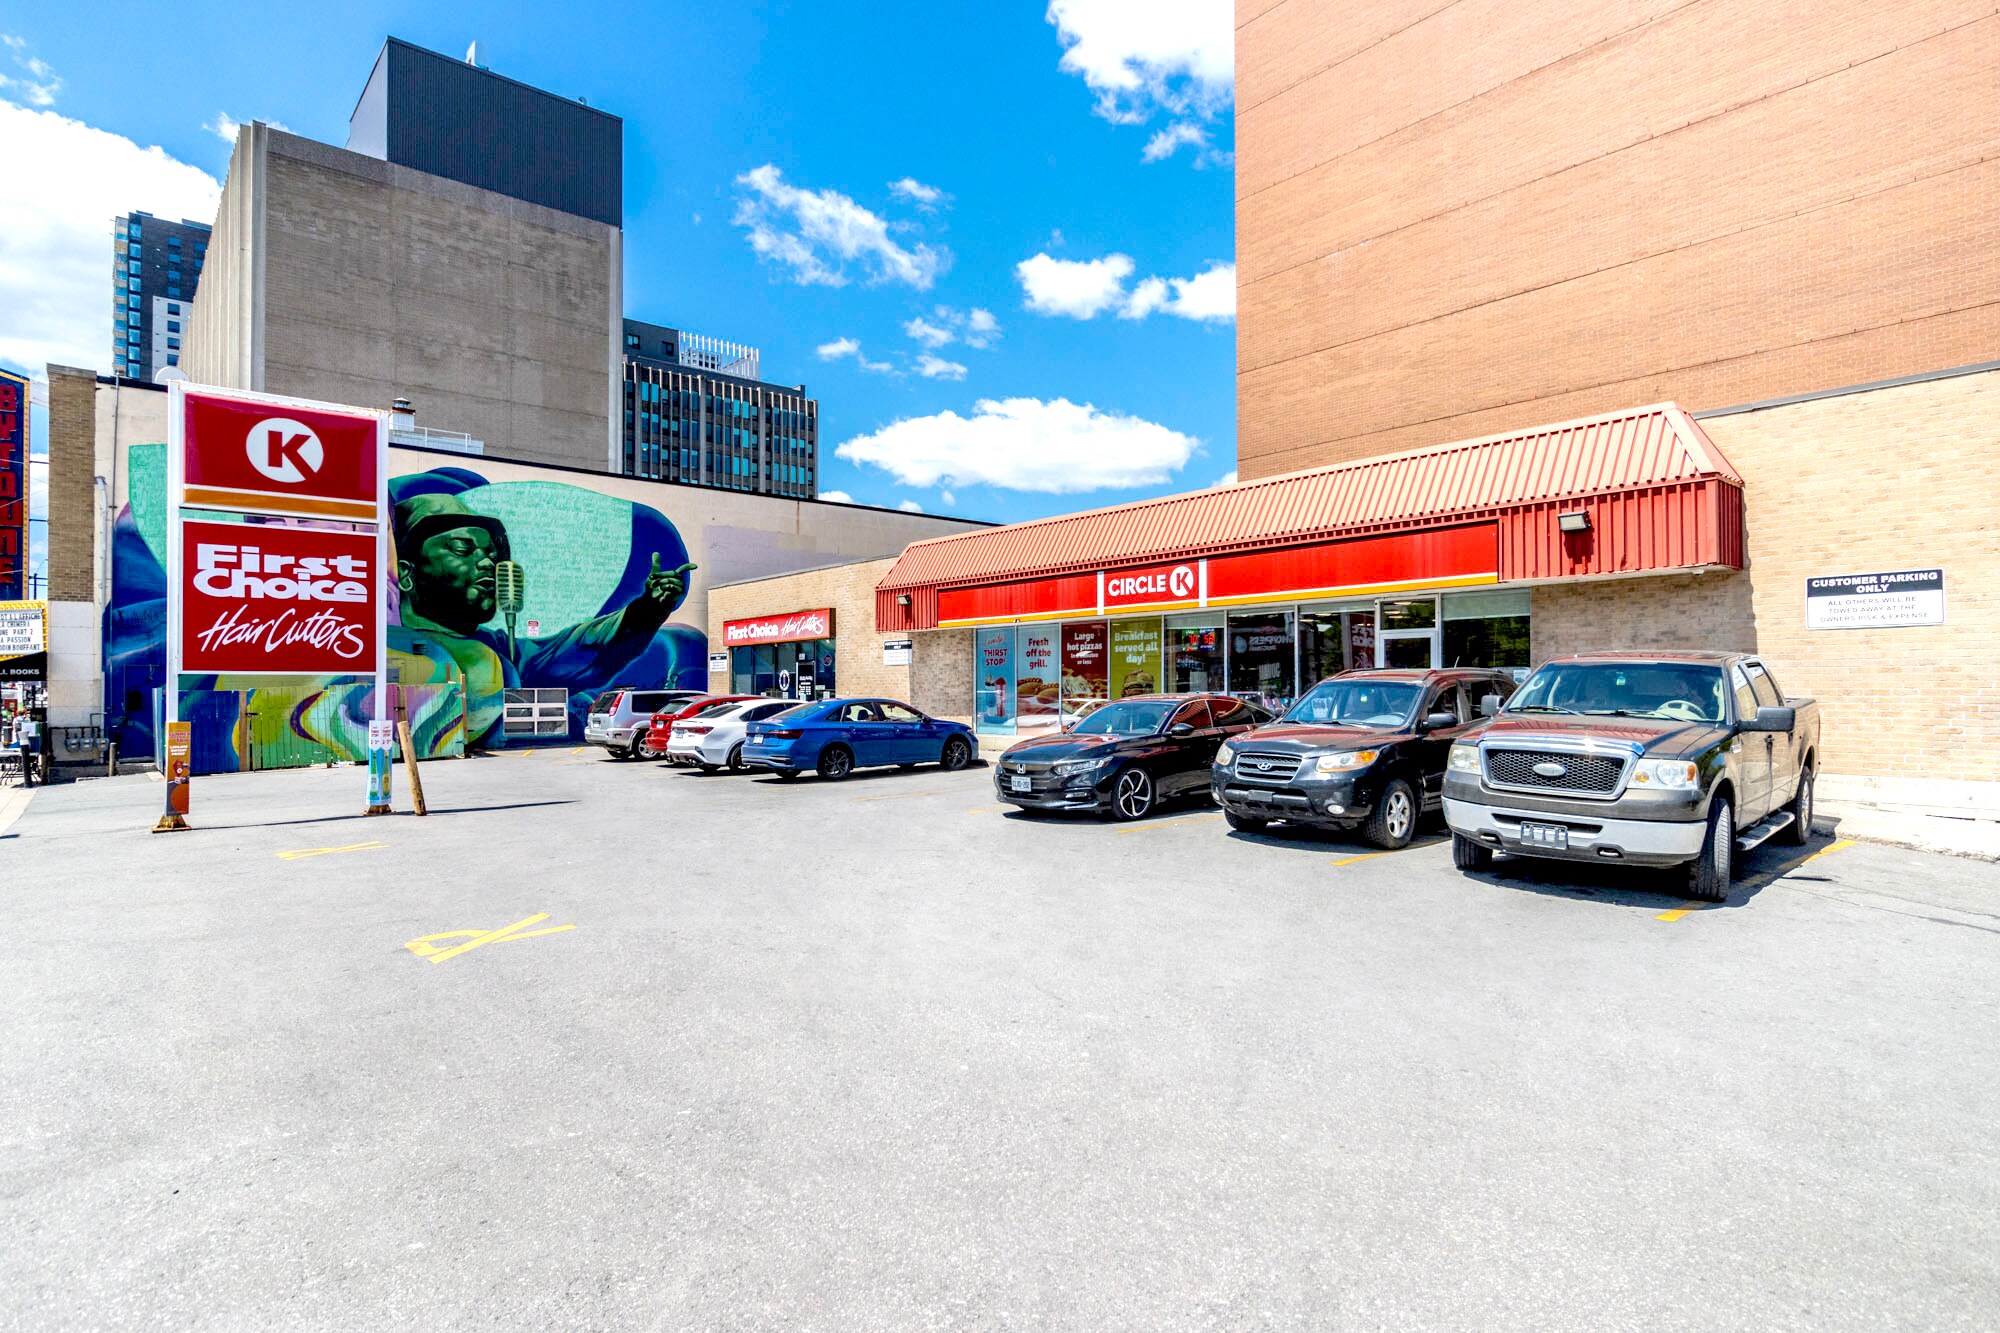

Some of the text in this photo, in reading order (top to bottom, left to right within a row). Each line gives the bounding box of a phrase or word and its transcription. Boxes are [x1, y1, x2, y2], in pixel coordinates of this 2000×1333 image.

[264, 427, 319, 482] K
[197, 543, 367, 578] First
[193, 567, 367, 603] Choice
[1108, 569, 1193, 596] CIRCLE K
[1812, 571, 1938, 588] CUSTOMER PARKING
[1855, 583, 1890, 593] ONLY
[1820, 615, 1855, 623] OWNERS
[727, 625, 749, 640] First
[748, 622, 779, 638] Choice
[1114, 631, 1158, 642] Breakfast
[1028, 637, 1049, 647] Fresh
[1074, 632, 1095, 642] Large
[1066, 641, 1103, 652] hot pizzas
[1114, 641, 1158, 653] served all
[983, 648, 1008, 657] THIRST
[1025, 648, 1052, 657] off the
[1029, 659, 1048, 670] grill.
[1126, 653, 1146, 665] day!
